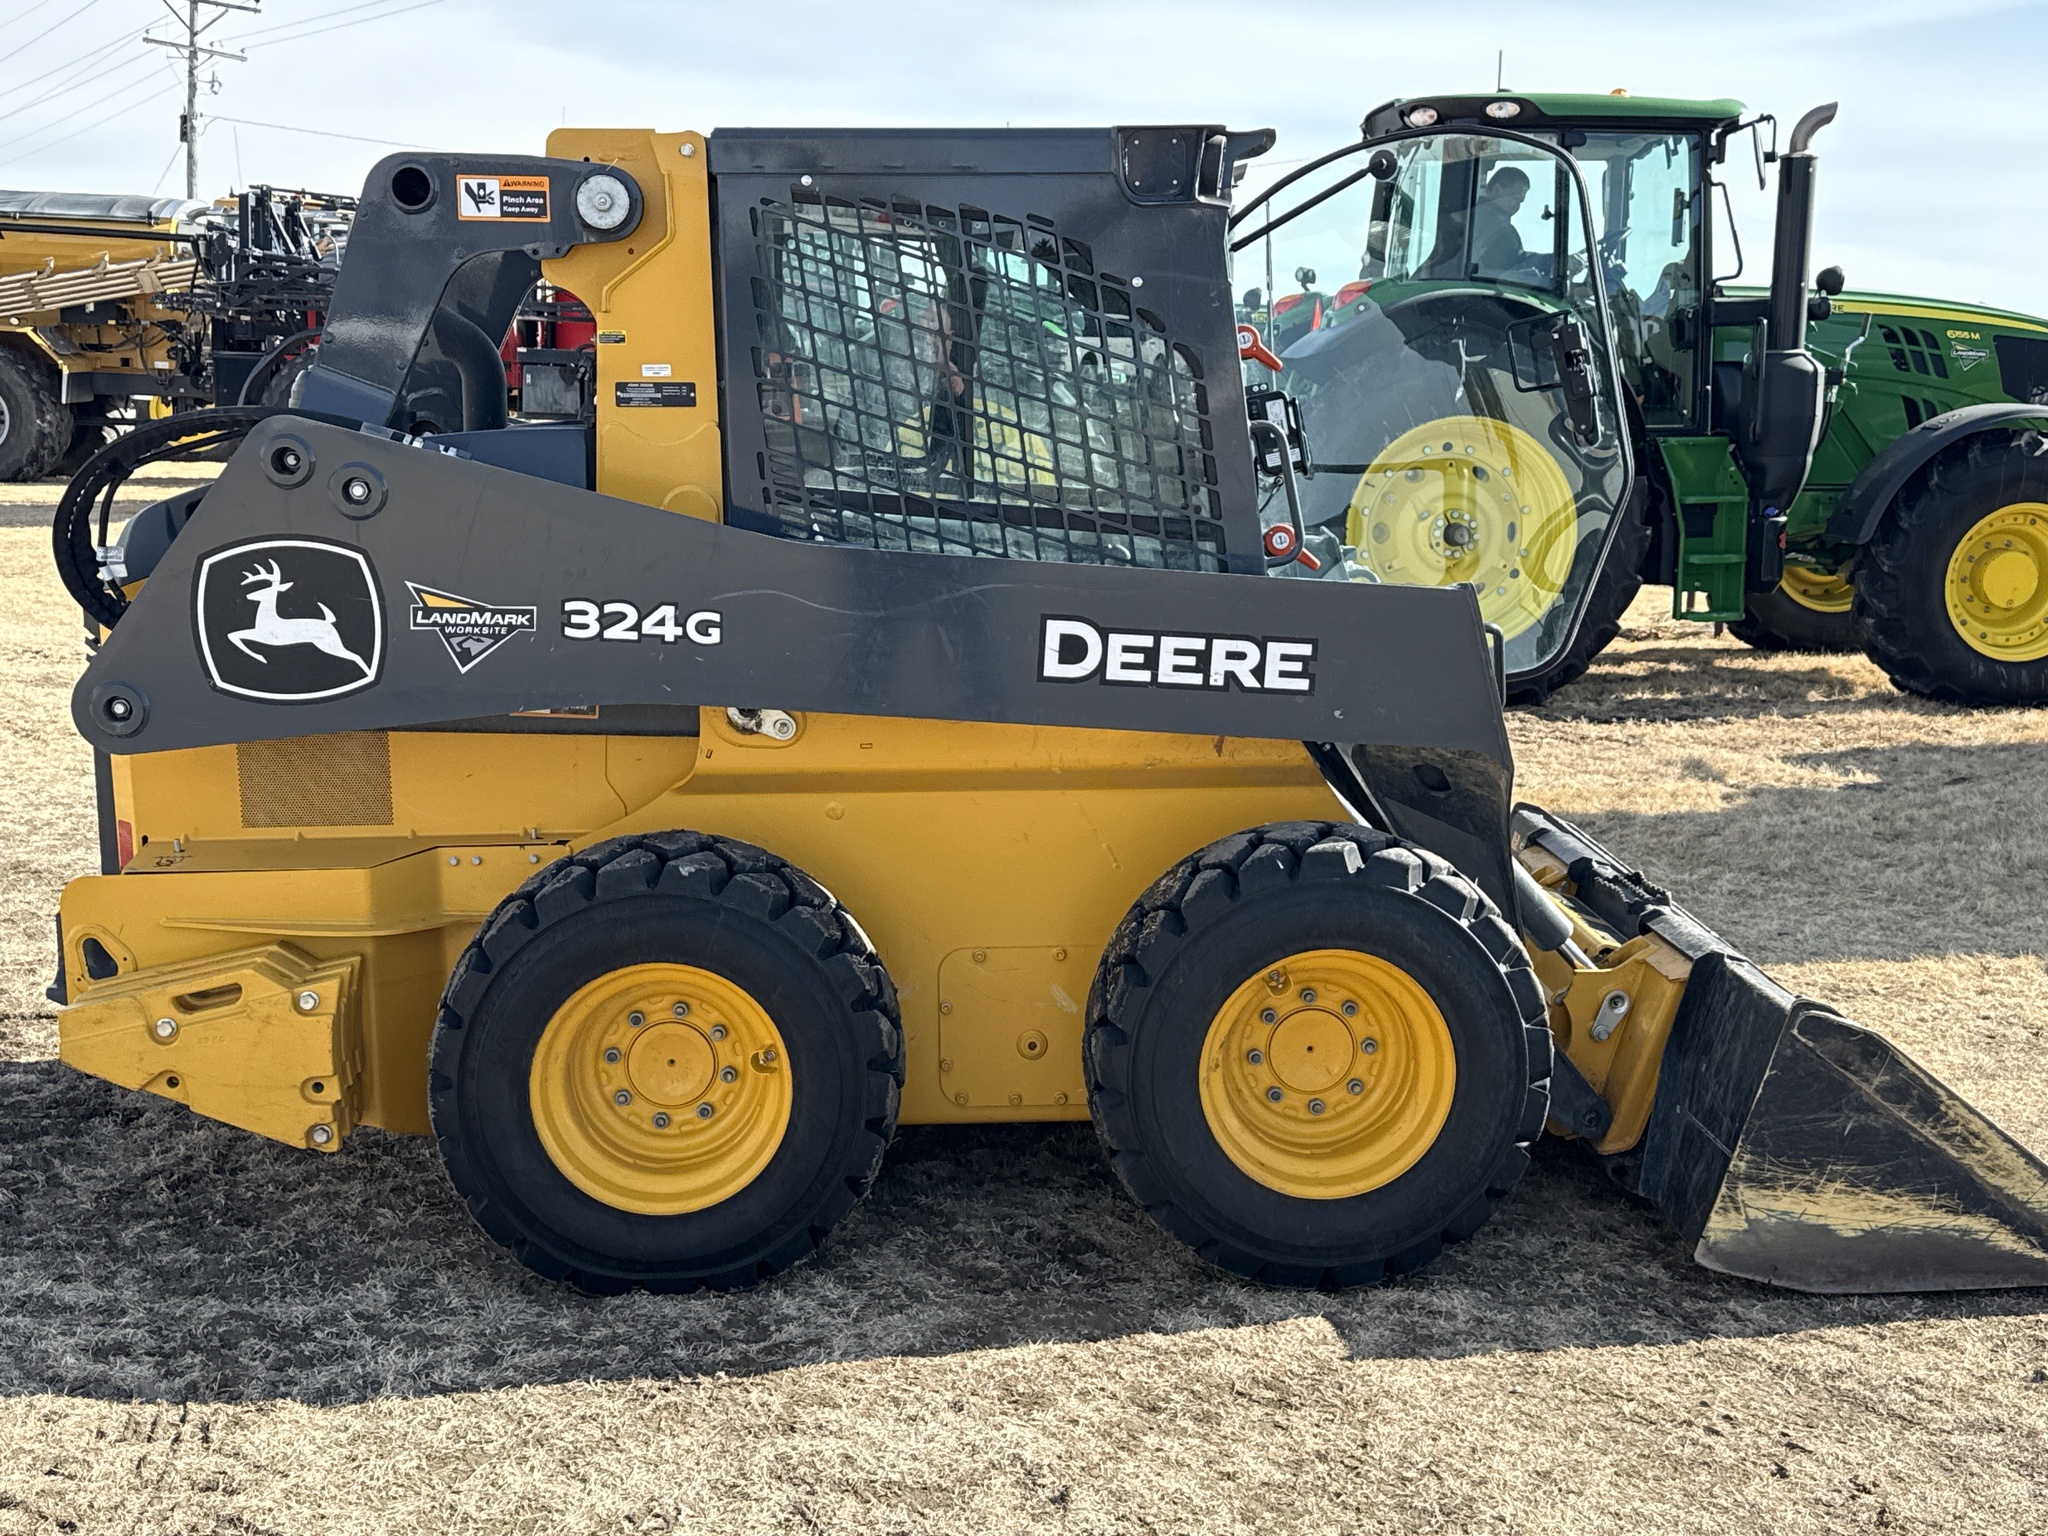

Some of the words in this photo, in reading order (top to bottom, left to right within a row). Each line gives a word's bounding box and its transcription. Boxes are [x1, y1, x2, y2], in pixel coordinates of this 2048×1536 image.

[510, 180, 545, 188] WARNING
[502, 195, 524, 204] Pinch
[525, 196, 544, 204] Area
[502, 205, 520, 213] Keep
[415, 610, 532, 626] LANDMARK
[562, 599, 722, 645] 324G
[444, 625, 508, 635] WORKSITE
[1042, 618, 1314, 691] DEERE
